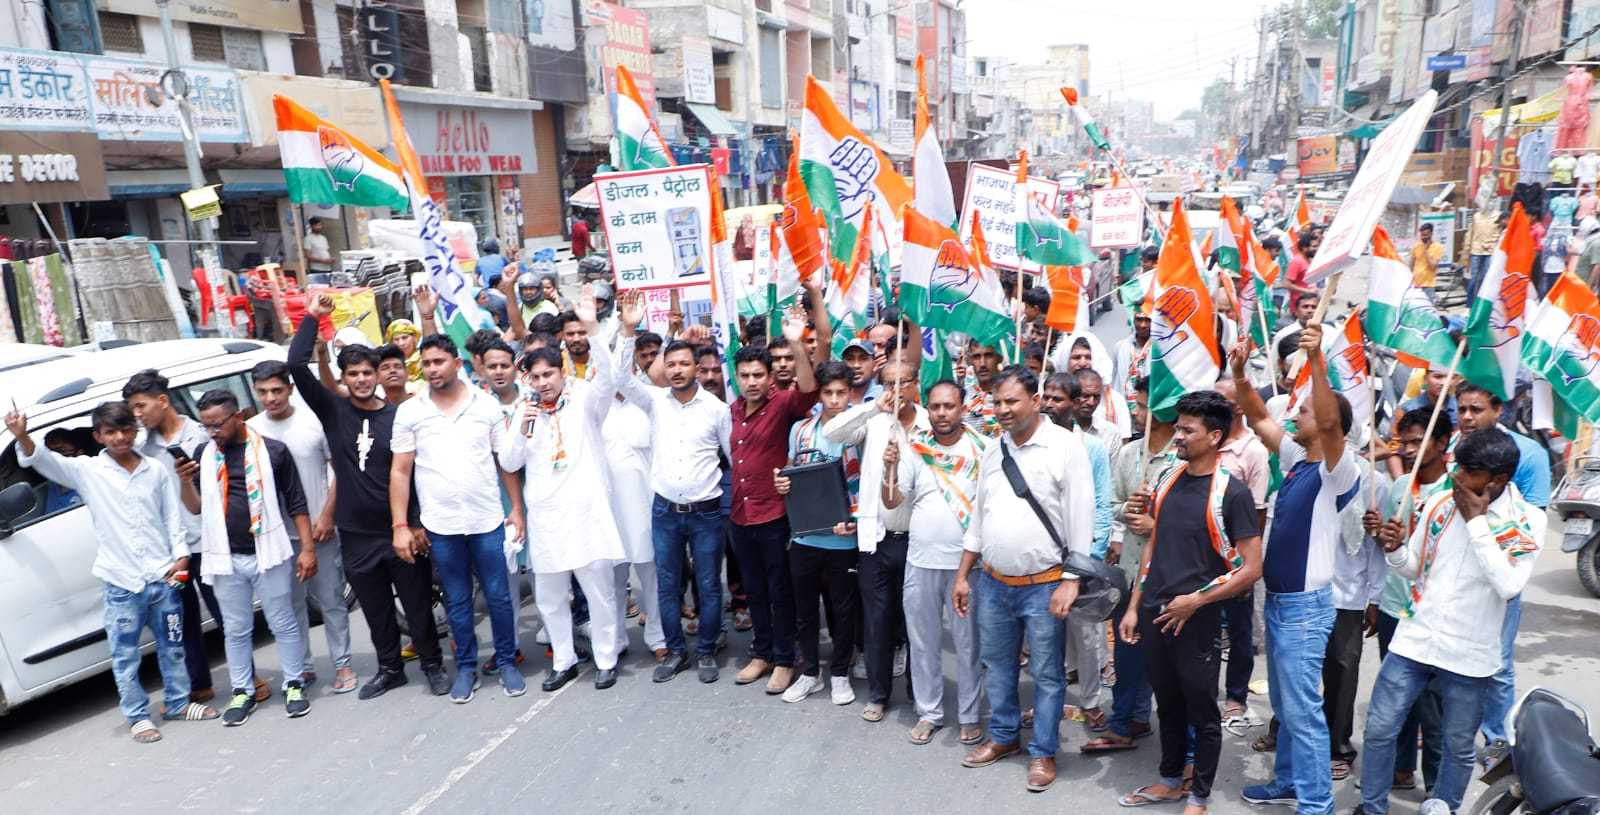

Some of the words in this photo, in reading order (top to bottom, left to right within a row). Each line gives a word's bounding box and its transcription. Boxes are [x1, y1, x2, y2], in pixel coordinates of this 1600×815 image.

[366, 0, 396, 79] LLO
[606, 20, 645, 48] SAGAR
[435, 110, 490, 153] Hello
[18, 154, 80, 182] DECOR
[488, 155, 523, 171] WEAR
[663, 174, 701, 198] पैट्रोल
[610, 210, 627, 228] के
[629, 211, 658, 226] दाम
[615, 240, 643, 255] कम
[168, 631, 183, 642] 17
